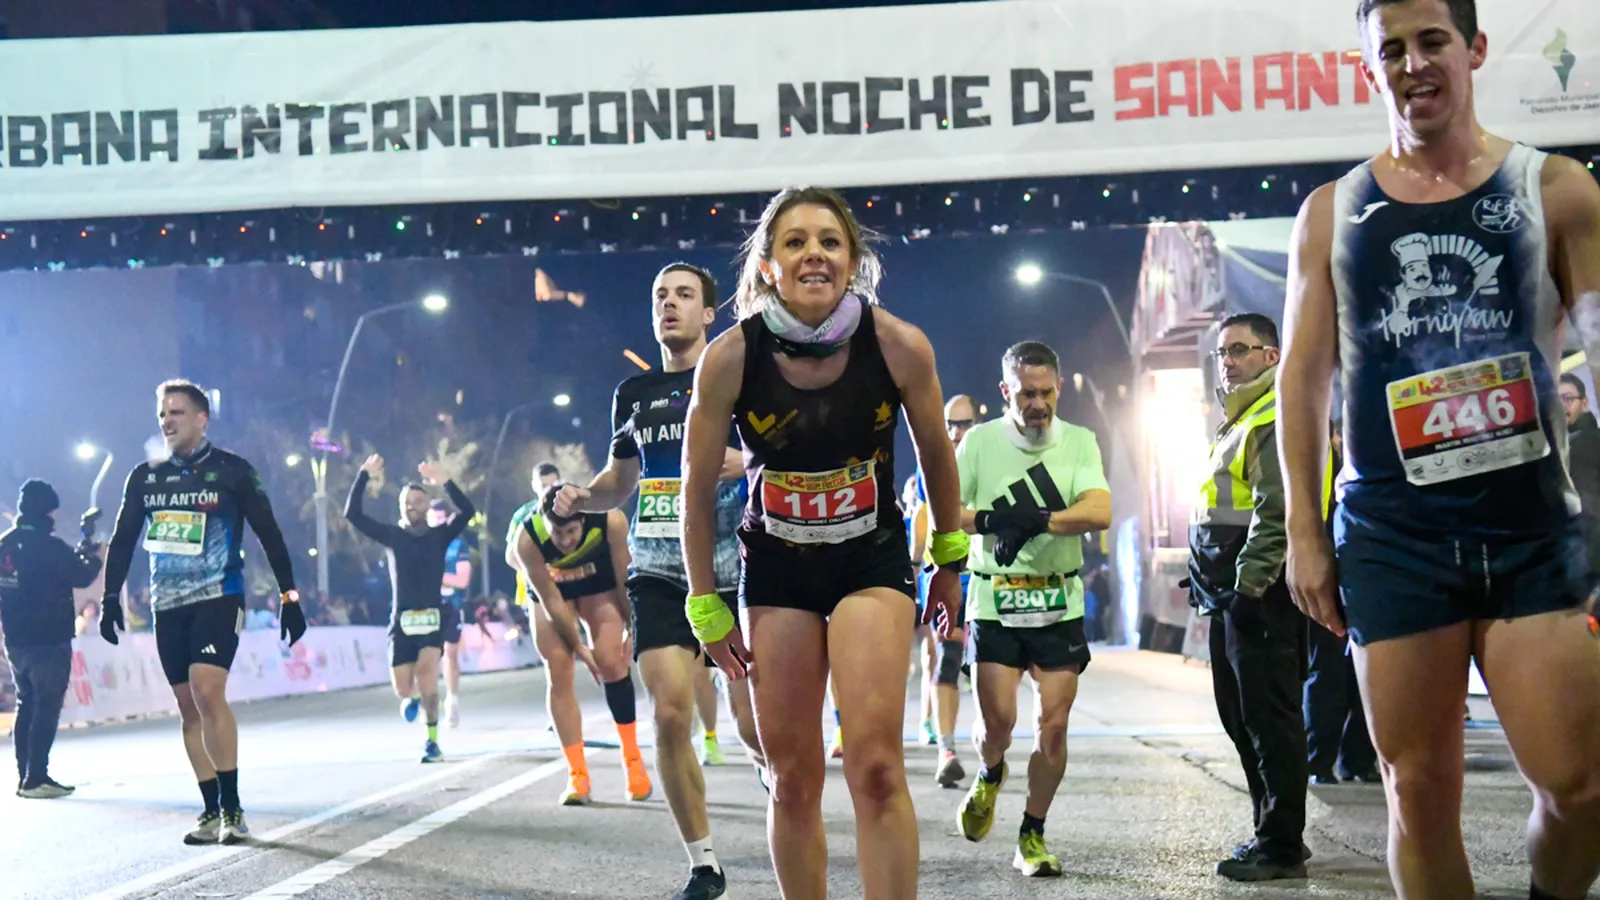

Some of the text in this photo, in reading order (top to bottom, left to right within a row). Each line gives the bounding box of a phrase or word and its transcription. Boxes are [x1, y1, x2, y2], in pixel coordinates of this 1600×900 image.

[0, 110, 178, 167] BANA
[199, 85, 759, 160] INTERNACIONAL
[778, 75, 991, 138] NOCHE
[1011, 68, 1094, 126] DE
[1115, 58, 1242, 121] SAN
[1422, 389, 1516, 438] 446
[143, 489, 218, 507] SAN ANTÓN
[784, 487, 857, 518] 112
[156, 522, 193, 538] 927
[998, 588, 1060, 610] 2807
